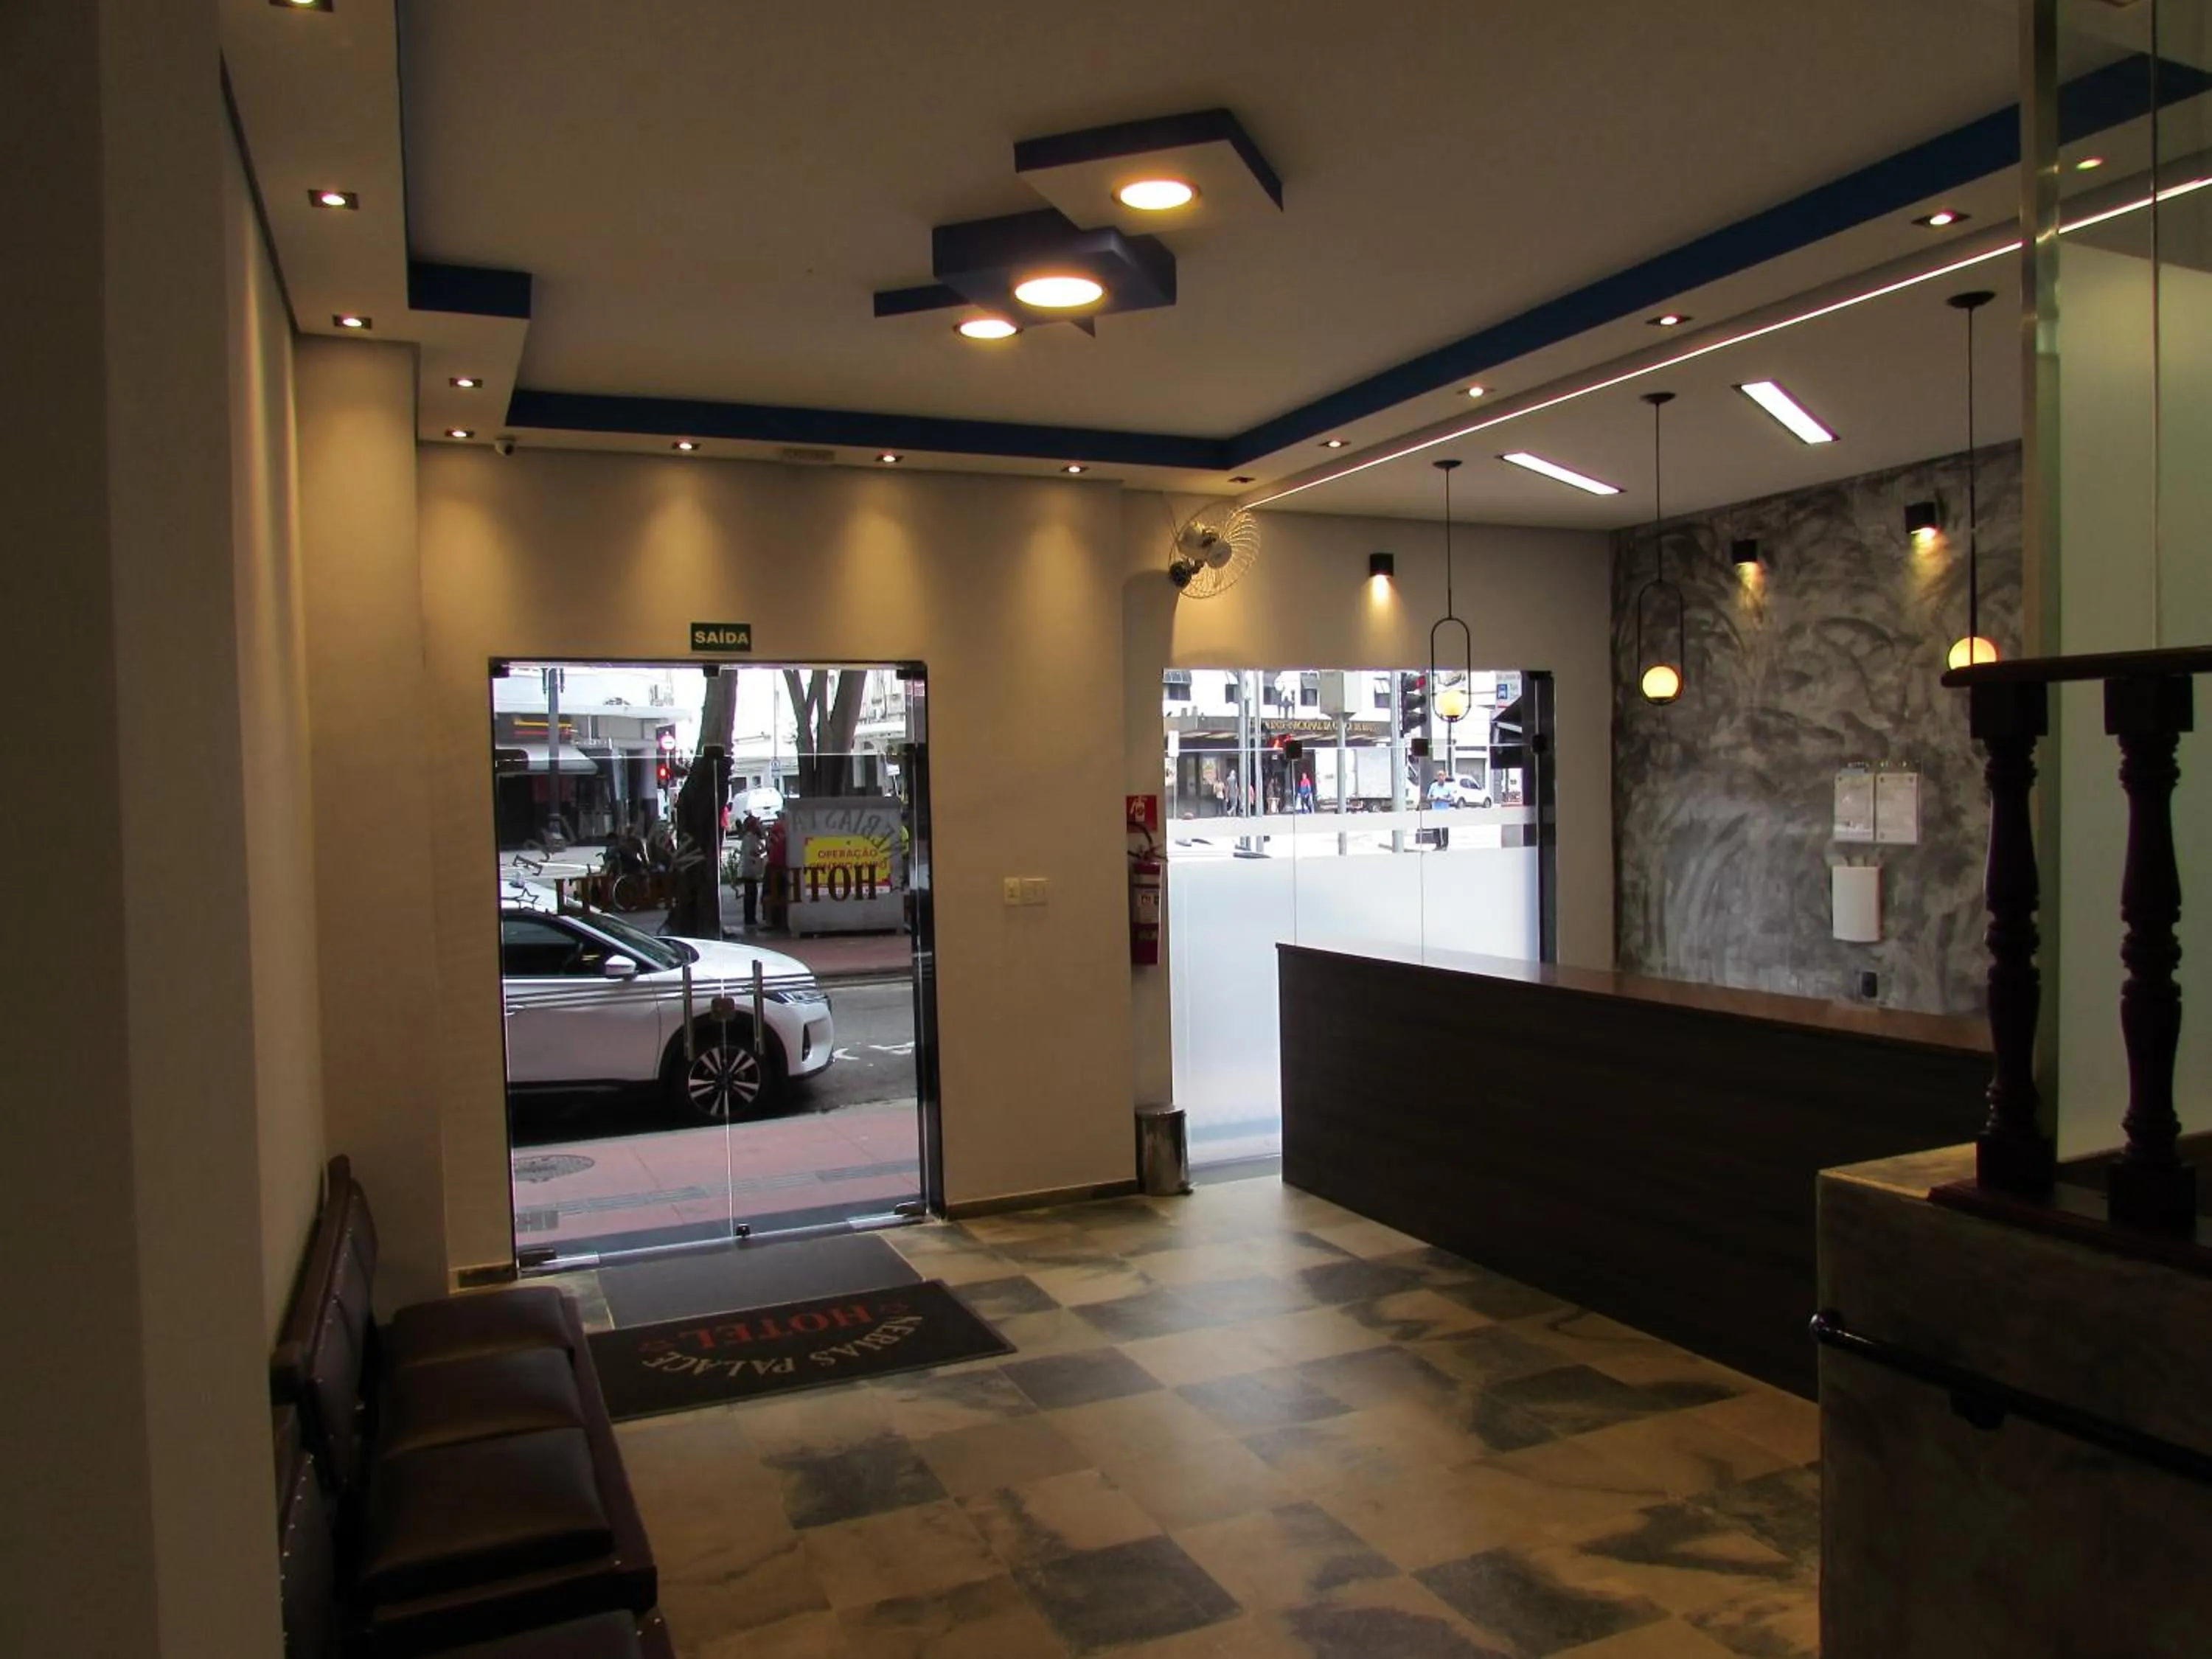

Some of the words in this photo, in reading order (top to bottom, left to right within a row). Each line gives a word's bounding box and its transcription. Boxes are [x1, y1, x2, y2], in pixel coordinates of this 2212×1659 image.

[695, 628, 748, 644] SAÍDA
[818, 847, 878, 859] OPERAÇÃO
[677, 1304, 874, 1349] HOTEL
[642, 1351, 796, 1377] PALACE
